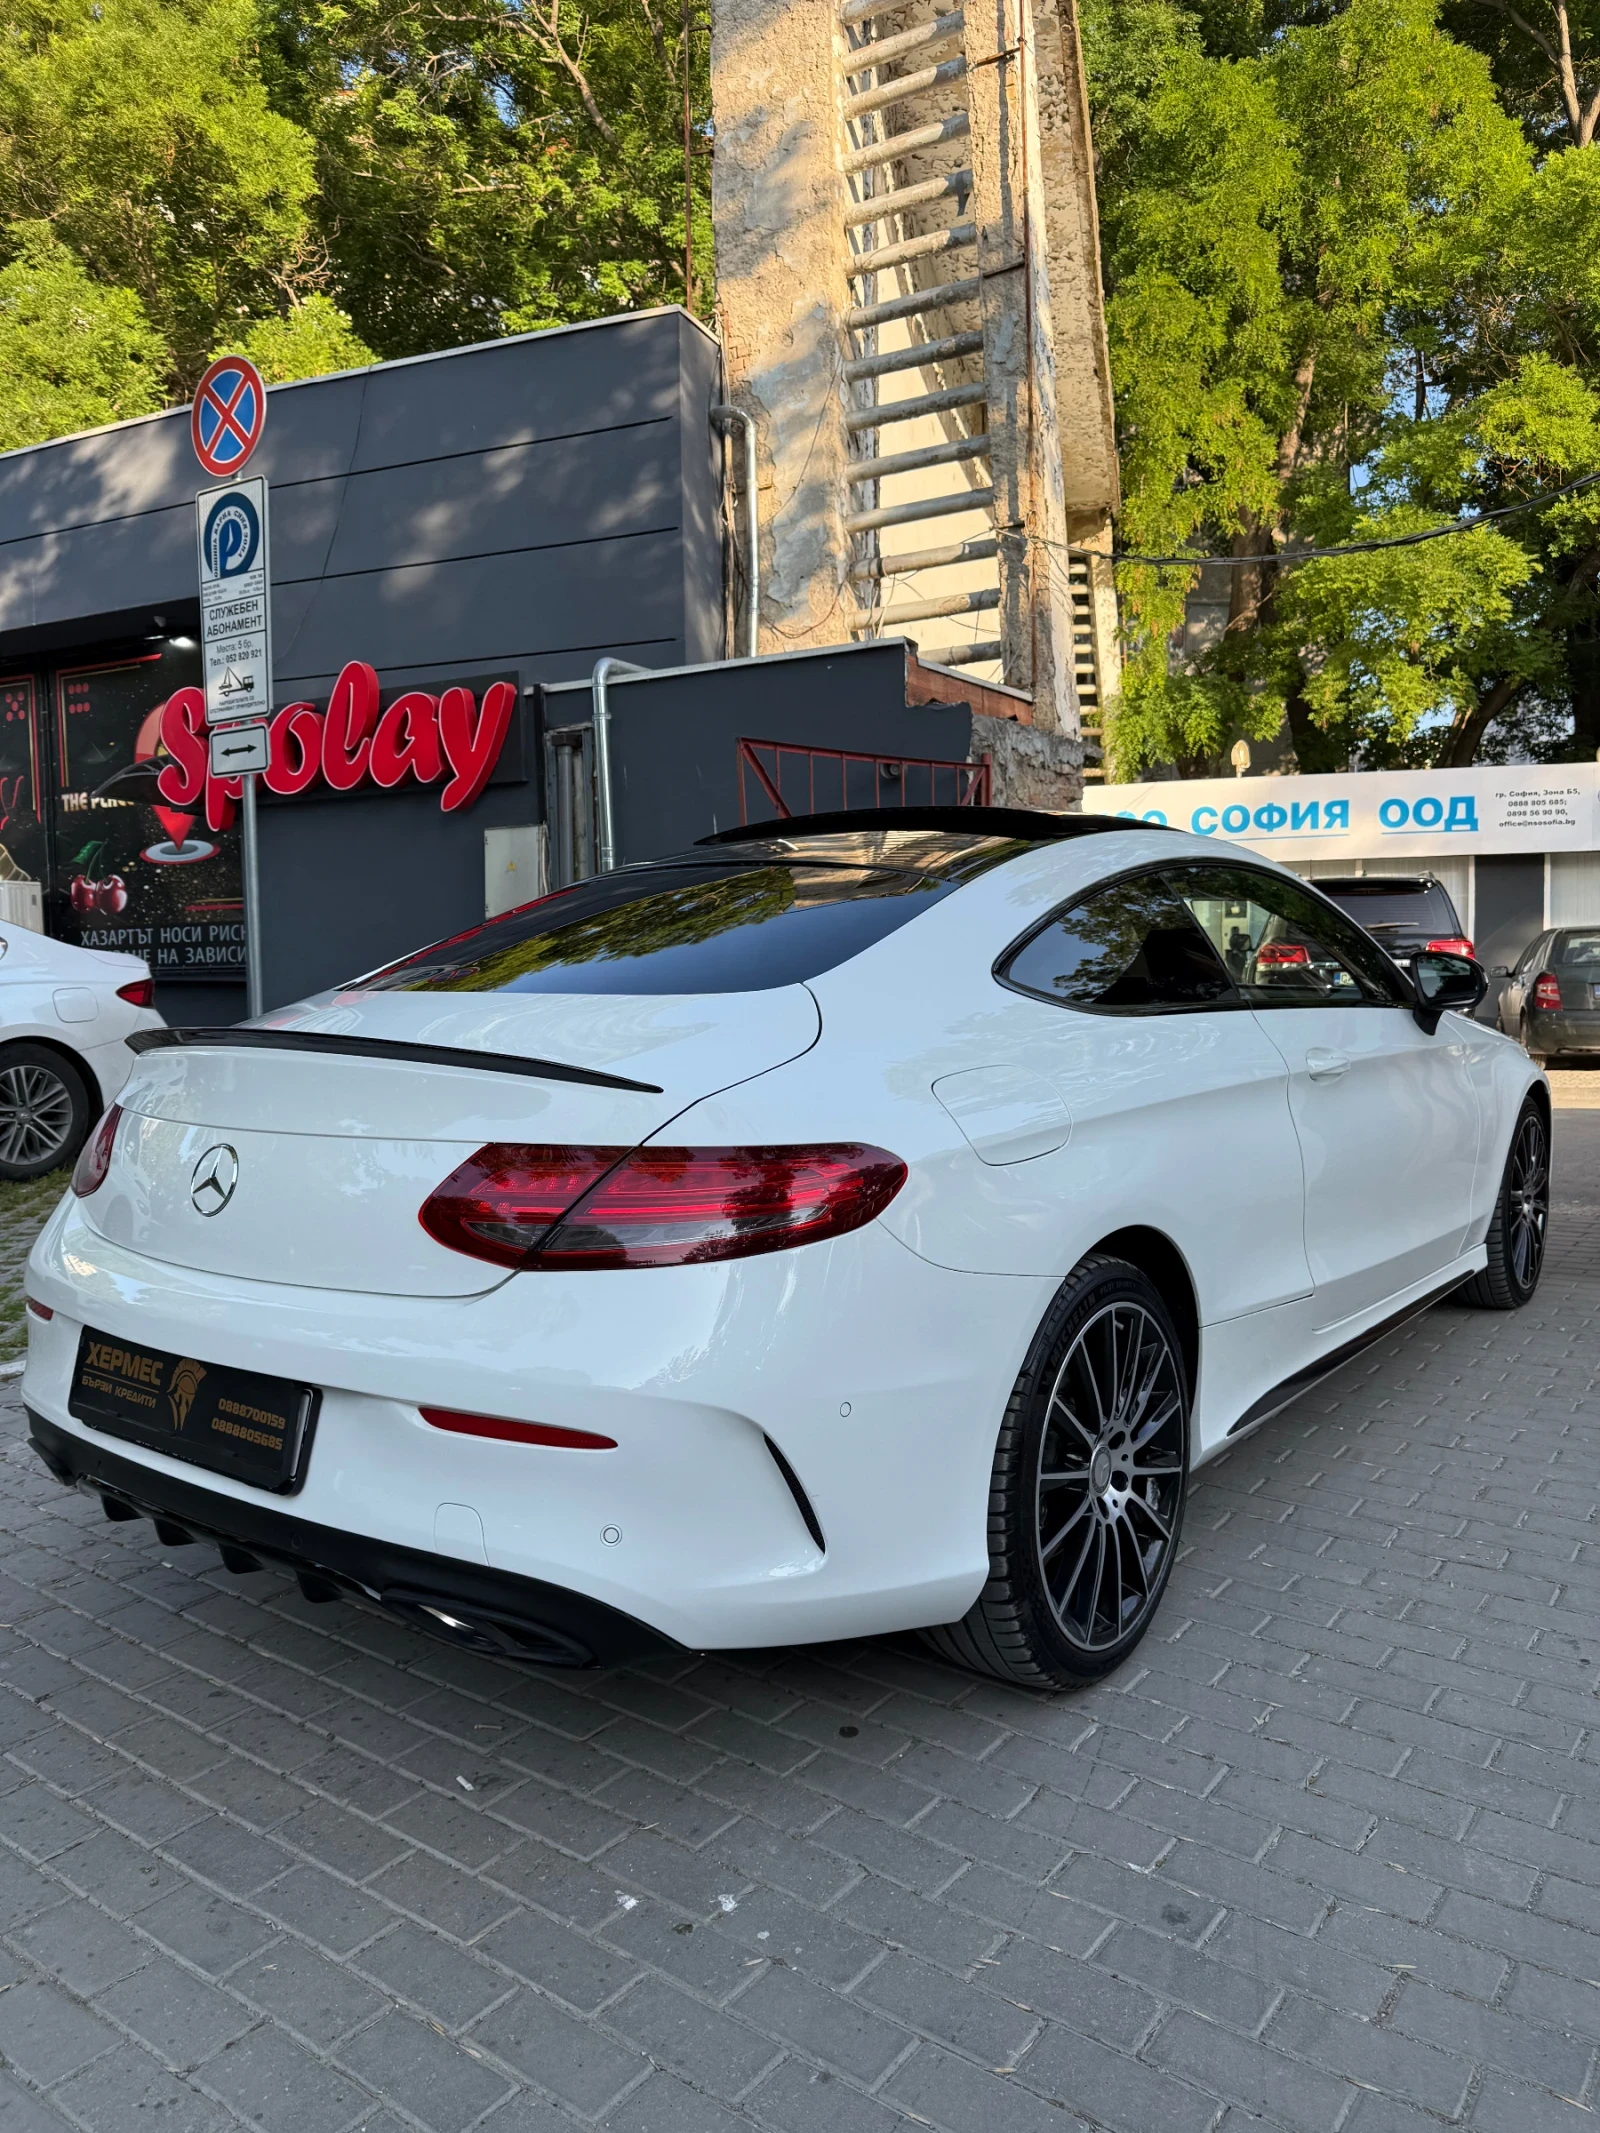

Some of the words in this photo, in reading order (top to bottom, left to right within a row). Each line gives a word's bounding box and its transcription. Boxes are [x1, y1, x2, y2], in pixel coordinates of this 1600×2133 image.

[238, 532, 249, 558] ЗОНА
[209, 599, 259, 621] СЛУЖЕБЕН
[206, 615, 263, 638] АБОНАМЕНТ
[216, 643, 237, 654] Места:
[238, 640, 243, 650] 5
[243, 639, 253, 651] бр.
[225, 653, 237, 664] 052
[238, 651, 250, 661] 820
[251, 649, 262, 659] 921
[61, 792, 89, 812] THE
[1509, 790, 1541, 798] София,
[1190, 799, 1350, 836] СОФИЯ
[1379, 795, 1479, 832] ООД
[1529, 809, 1540, 817] 56
[81, 927, 153, 946] ХАЗАРТЪТ
[160, 926, 202, 944] НОСИ
[157, 948, 179, 965] НА
[1050, 1291, 1097, 1368] MICHELIN
[85, 1341, 163, 1386] ХЕРМЕС
[81, 1375, 113, 1394] БЪРЗИ
[114, 1386, 157, 1409] КРЕДИТИ
[218, 1397, 286, 1430] 0888700159
[211, 1417, 283, 1451] 0888805685
